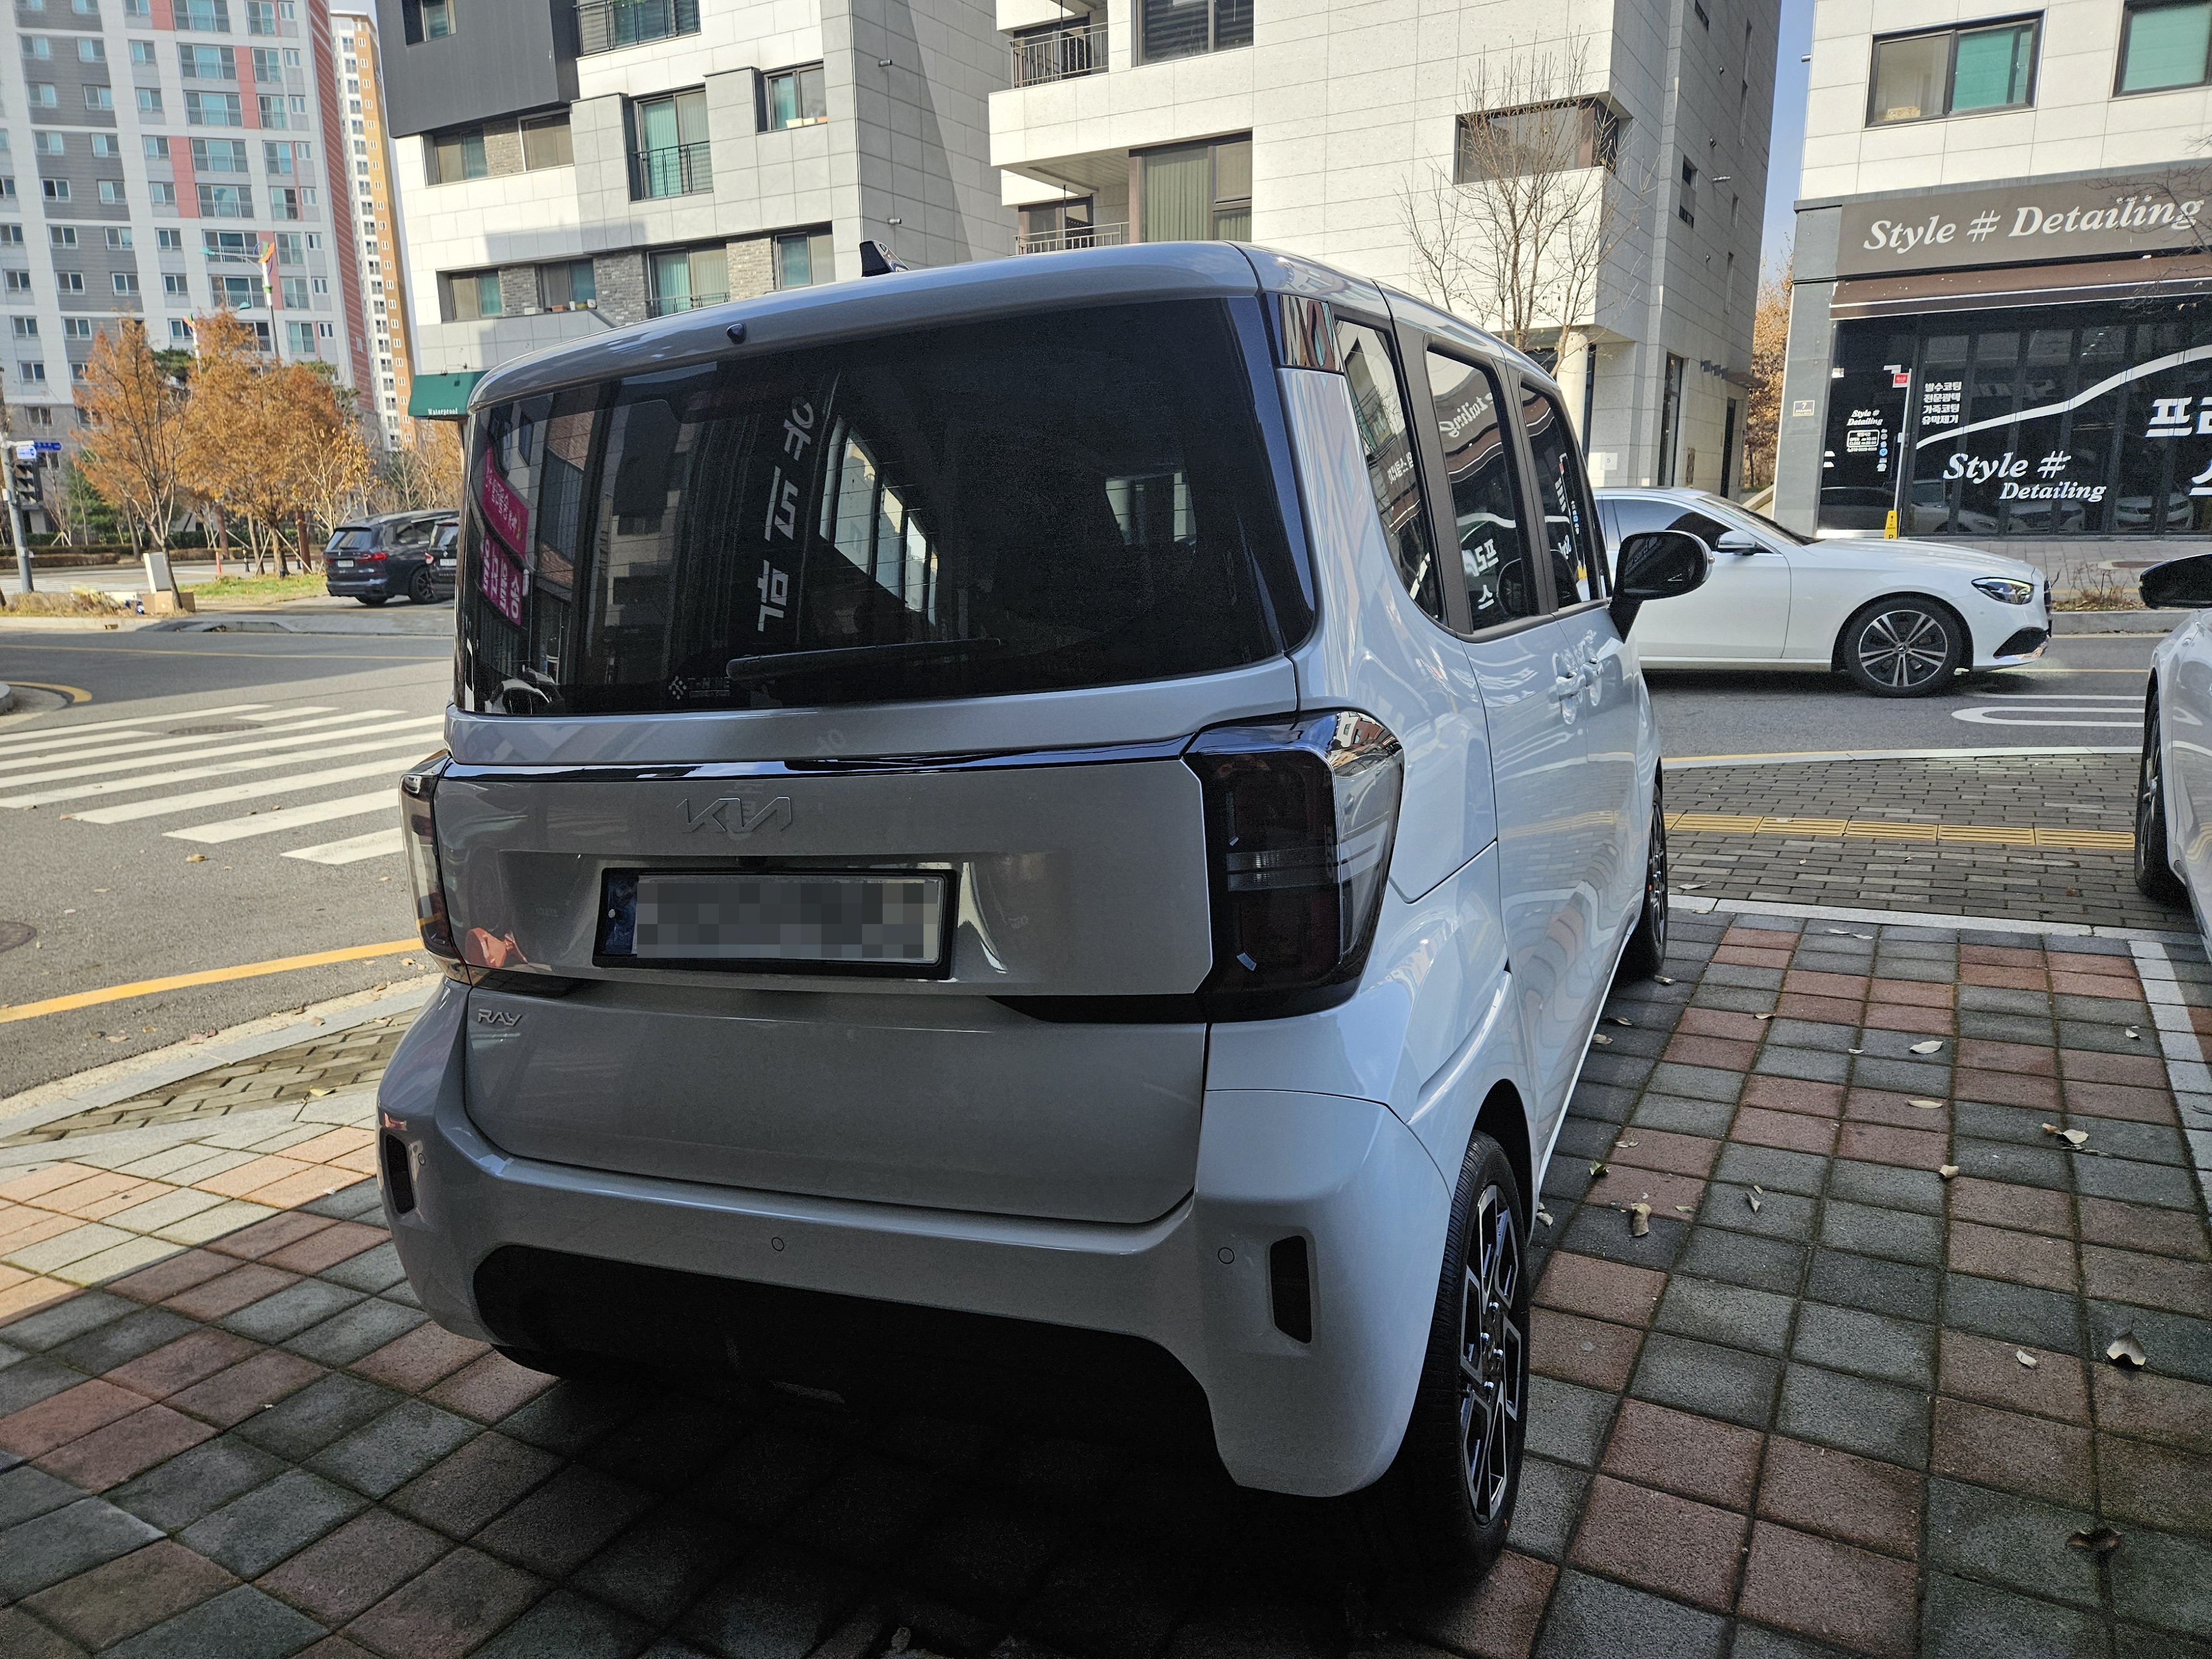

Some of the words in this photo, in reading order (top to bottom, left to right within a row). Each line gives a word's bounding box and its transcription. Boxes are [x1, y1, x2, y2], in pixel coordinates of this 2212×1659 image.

[1863, 214, 1956, 254] Style
[1966, 210, 2001, 242] #
[2008, 195, 2205, 237] Detailing
[1851, 409, 1871, 418] Style
[1943, 452, 2028, 484] Style
[2037, 451, 2072, 478] #
[2000, 481, 2106, 503] Detailing
[478, 1008, 521, 1026] RAY
